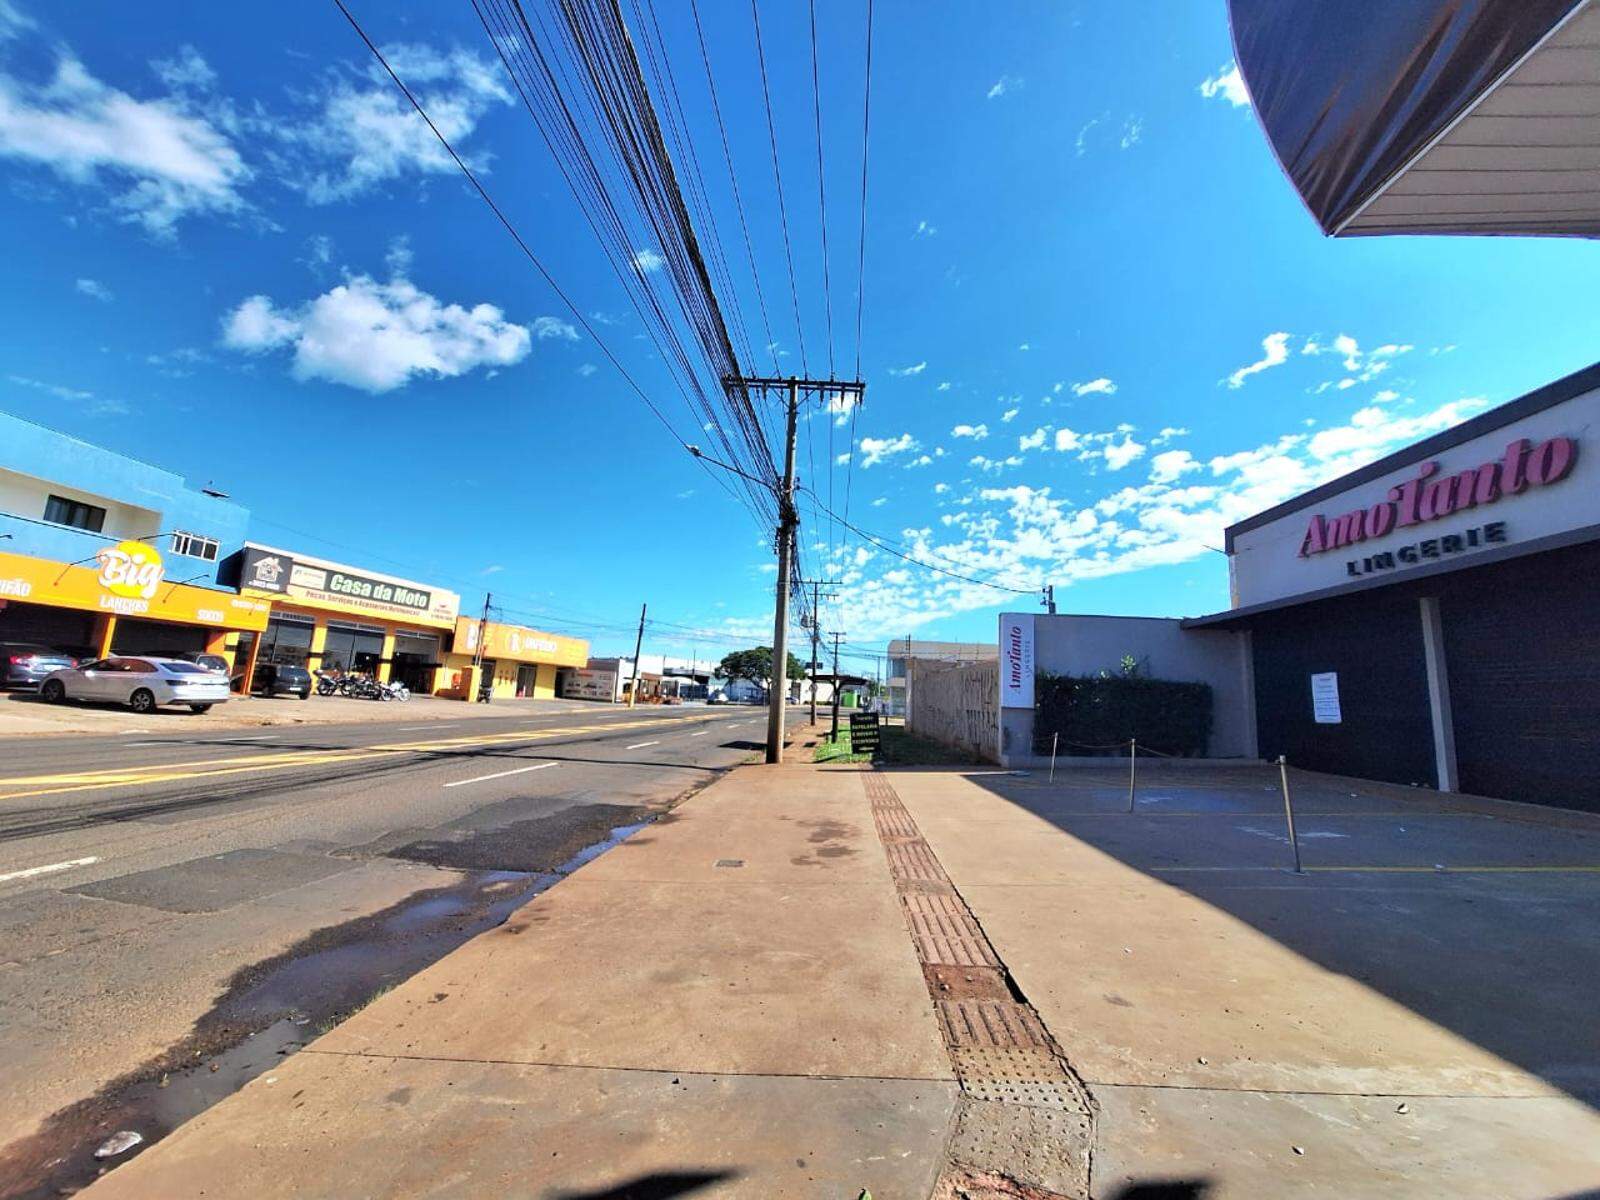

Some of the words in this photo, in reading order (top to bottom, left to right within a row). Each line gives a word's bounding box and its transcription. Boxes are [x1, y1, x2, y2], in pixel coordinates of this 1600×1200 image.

[1297, 437, 1578, 558] AmoTanto
[96, 549, 164, 600] Big
[1346, 521, 1508, 577] LINGERIE
[330, 574, 371, 597] Casa
[373, 584, 392, 601] da
[393, 587, 428, 608] Moto
